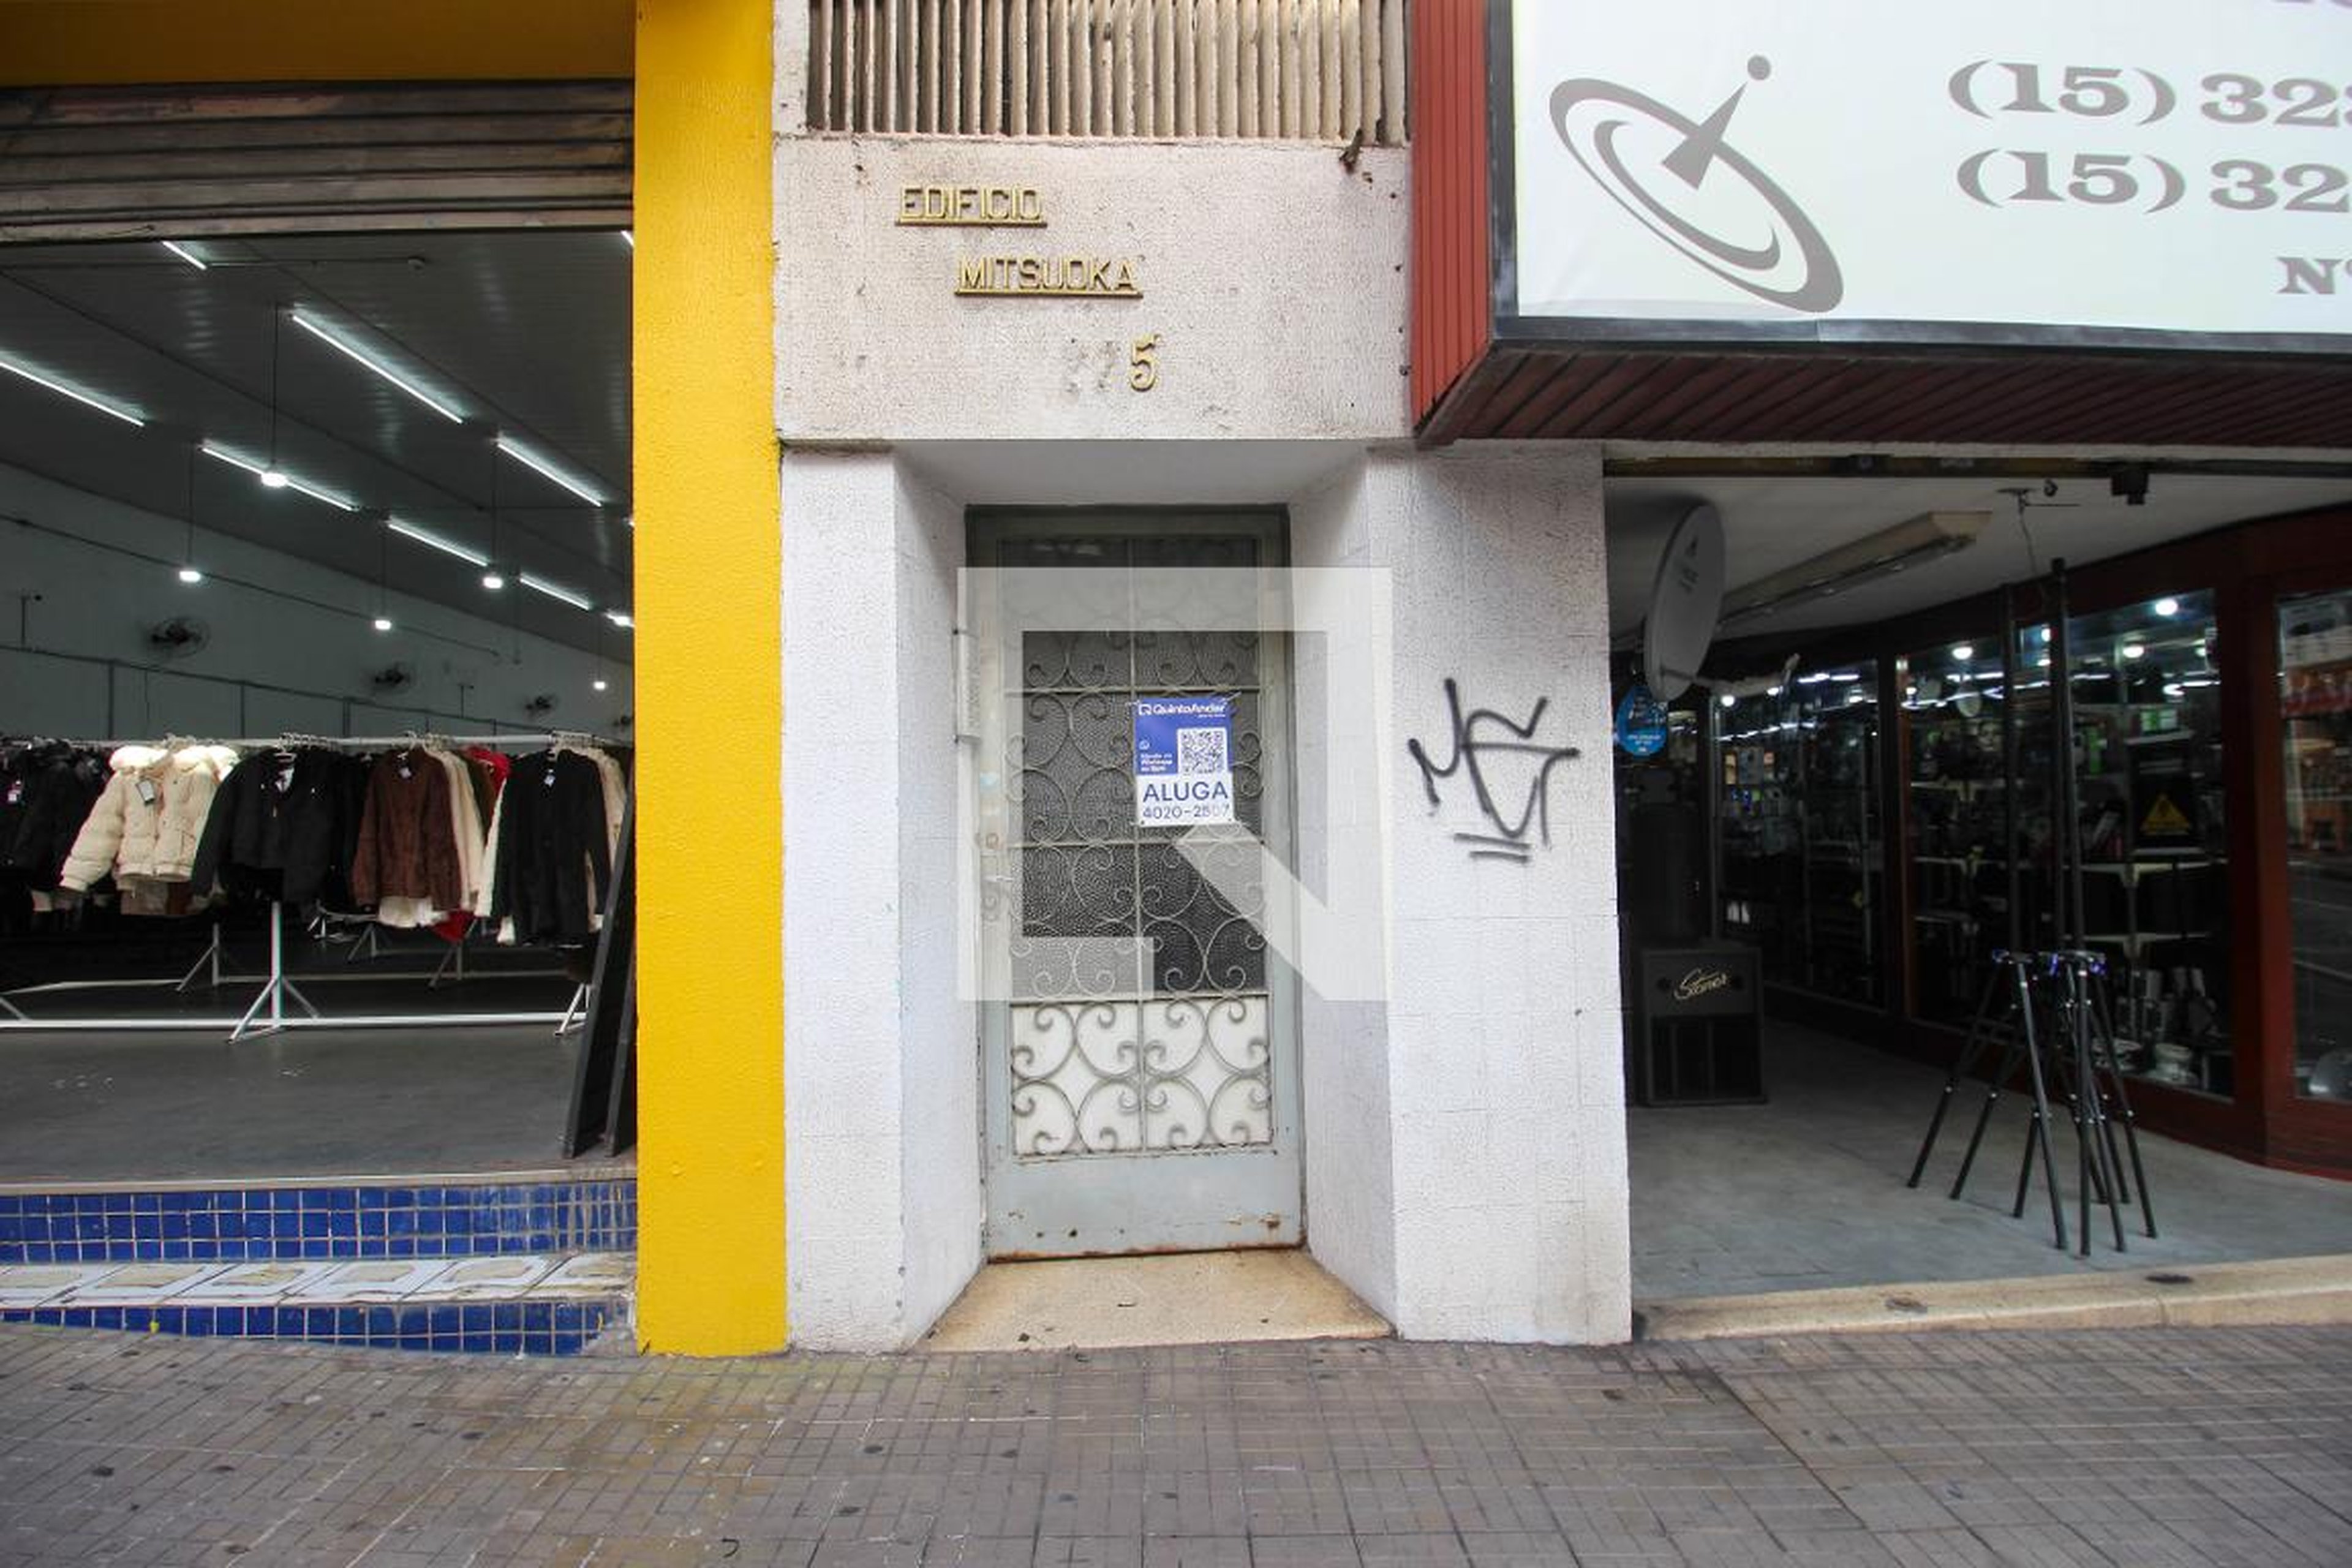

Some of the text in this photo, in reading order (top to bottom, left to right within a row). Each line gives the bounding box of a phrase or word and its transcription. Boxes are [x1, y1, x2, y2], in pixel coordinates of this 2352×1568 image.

[1948, 60, 2352, 127] (15) 32
[899, 186, 1043, 222] EDIFICIO
[1957, 148, 2185, 214] (15)
[959, 256, 1138, 292] MITSUOKA
[1130, 334, 1160, 392] 5
[1143, 781, 1228, 802] ALUGA
